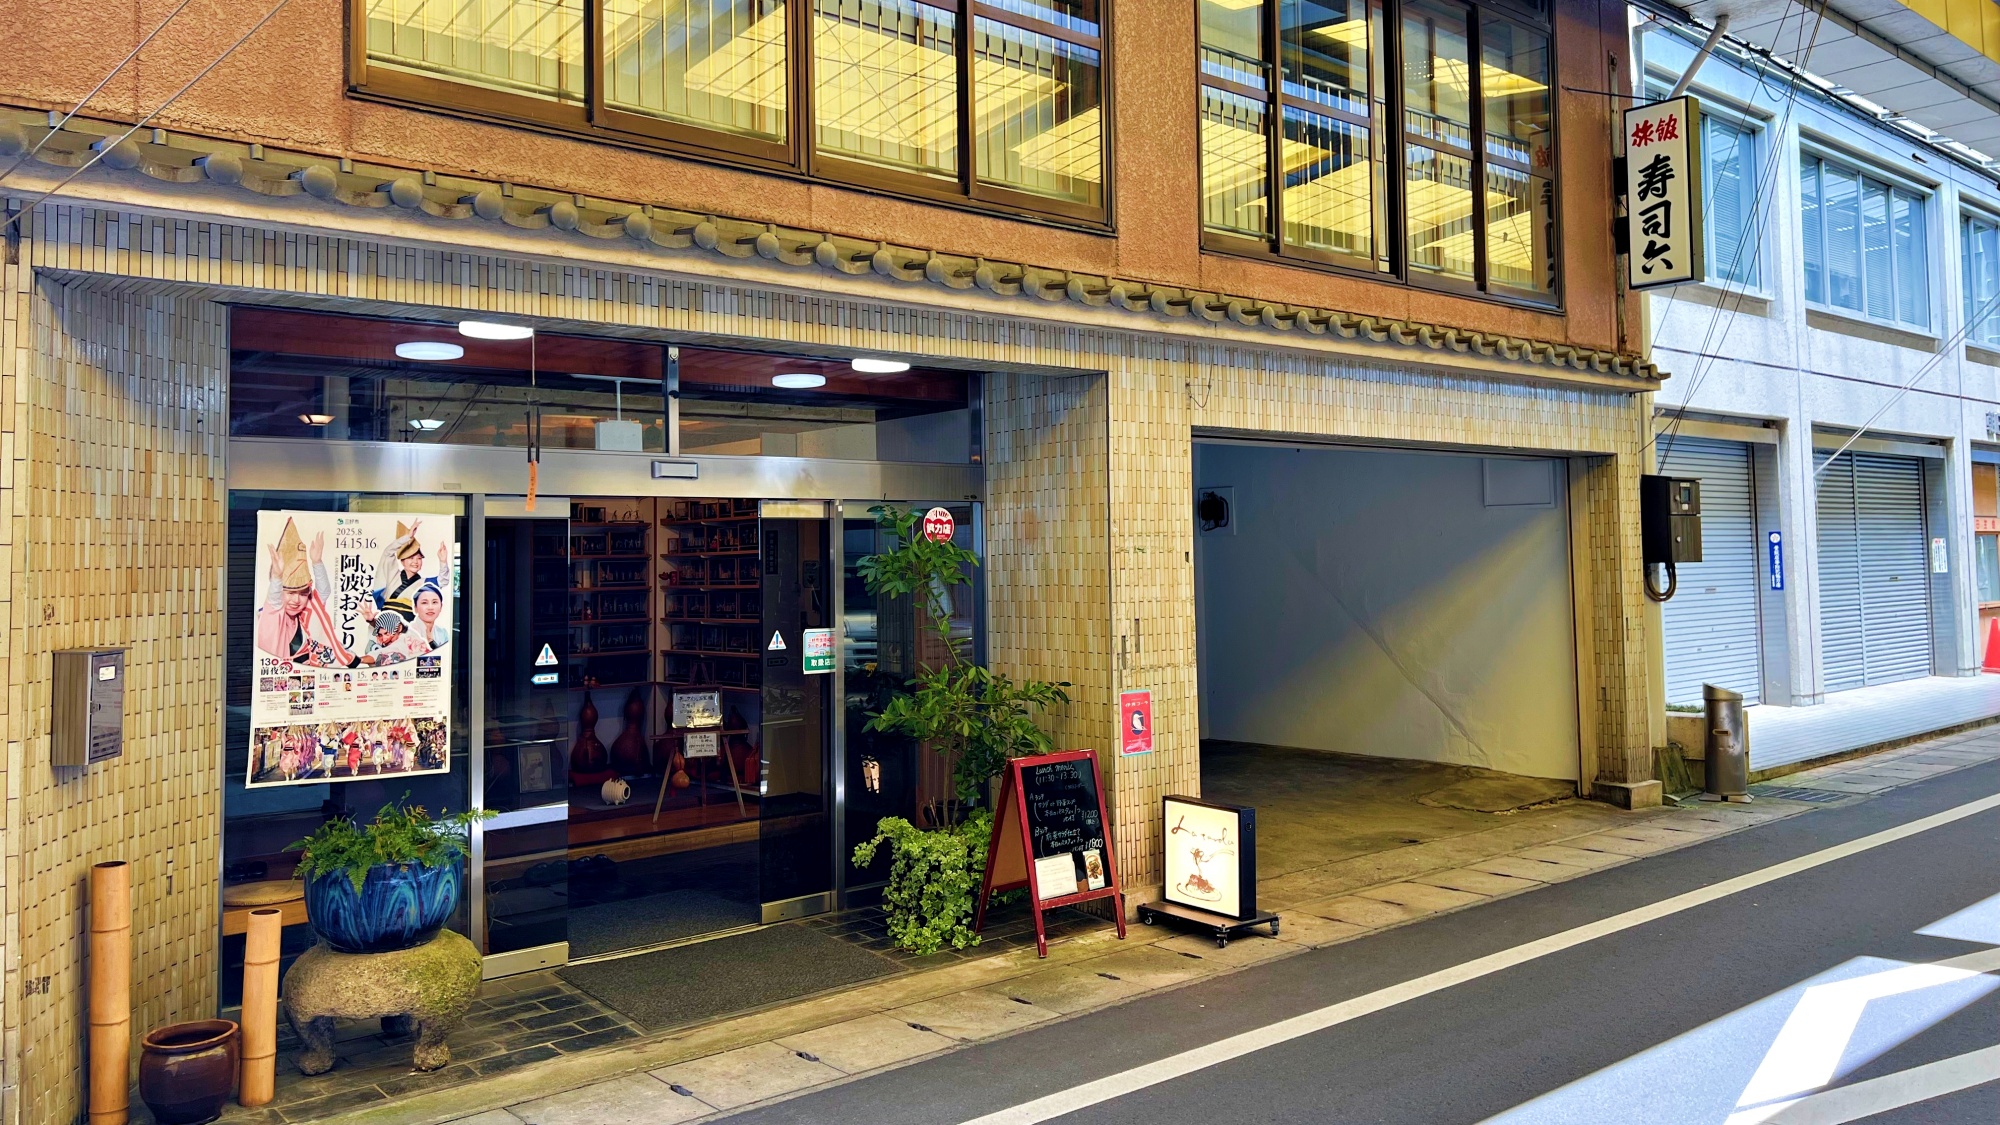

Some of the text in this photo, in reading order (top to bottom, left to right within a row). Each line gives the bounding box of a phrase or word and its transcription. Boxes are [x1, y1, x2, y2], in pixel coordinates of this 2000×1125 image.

[1637, 153, 1675, 275] 寿司六
[336, 528, 362, 536] 2025.8
[359, 563, 375, 602] いけだ
[340, 554, 360, 650] 阿波おどり
[260, 658, 271, 666] 13
[811, 658, 835, 667] 取扱店
[260, 664, 290, 675] 前夜祭
[404, 669, 412, 677] 16
[357, 671, 365, 679] 15
[1036, 764, 1053, 775] Lunch
